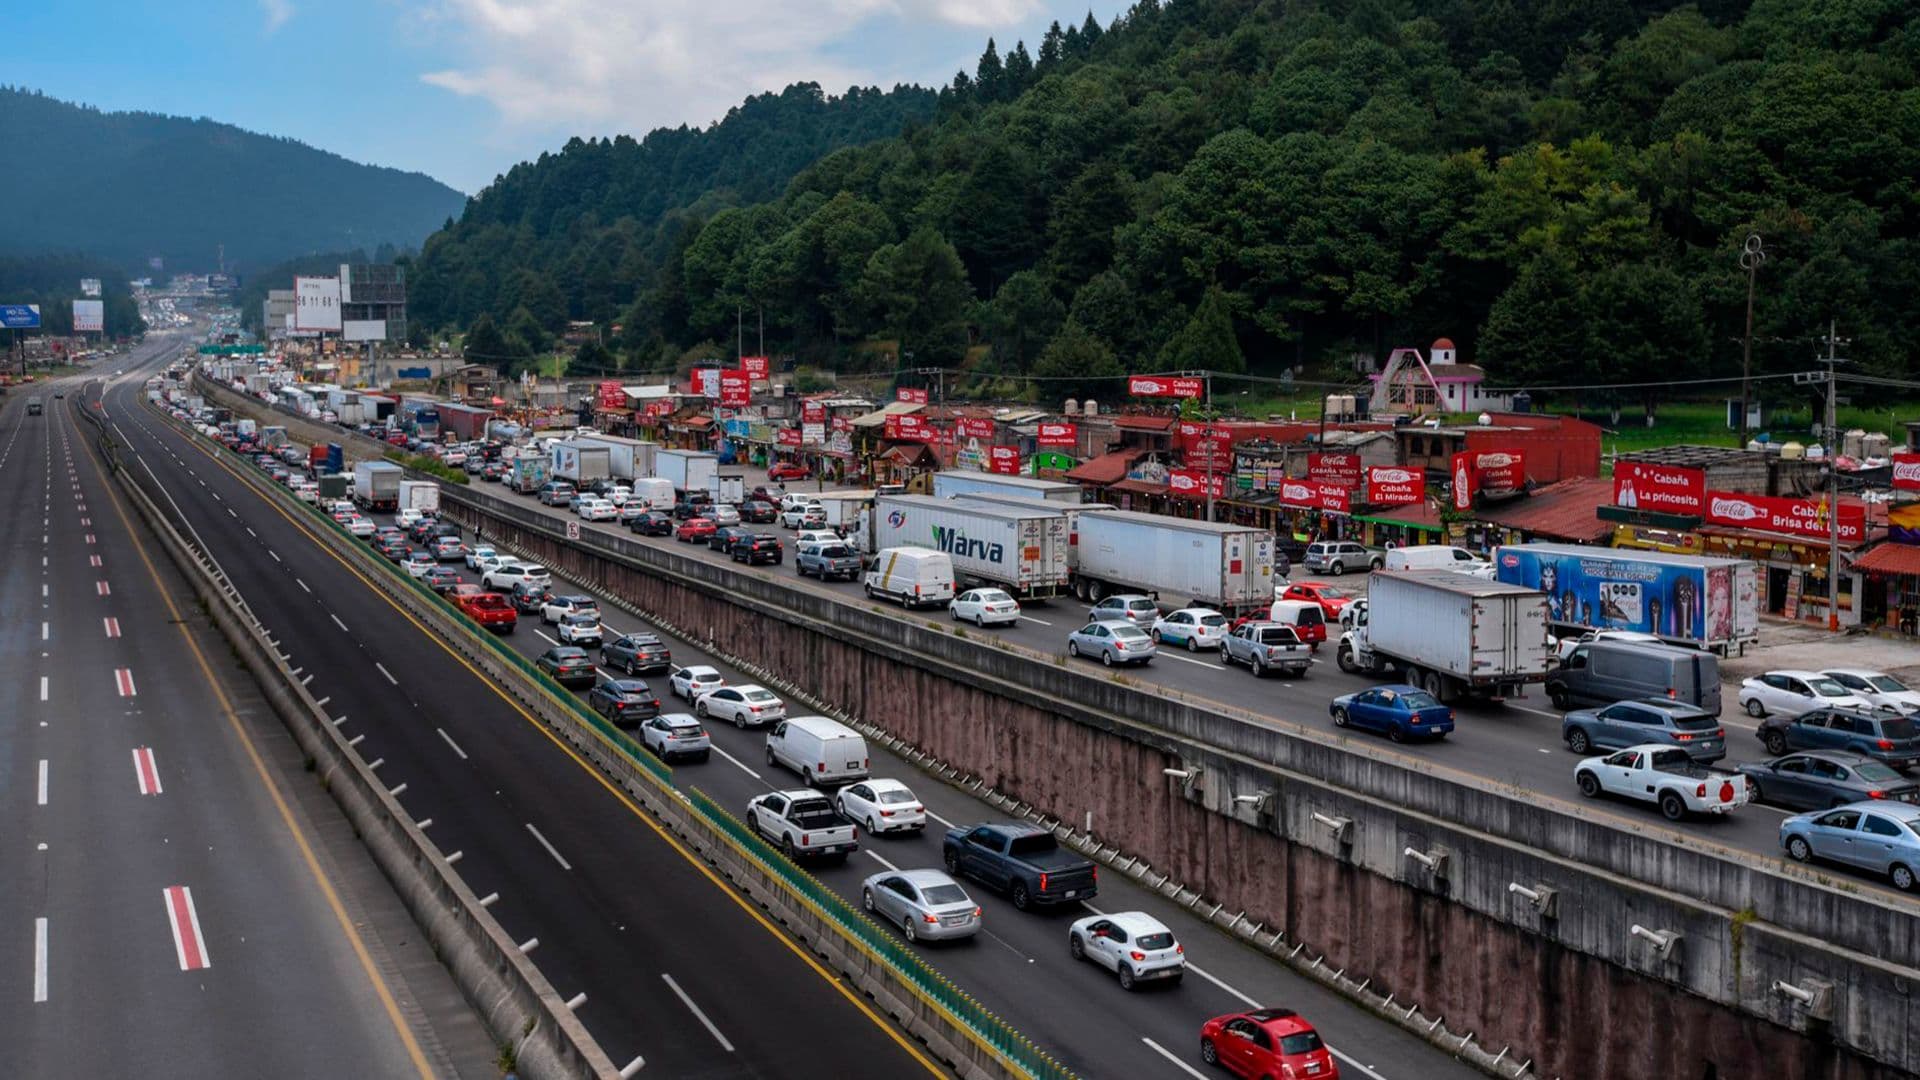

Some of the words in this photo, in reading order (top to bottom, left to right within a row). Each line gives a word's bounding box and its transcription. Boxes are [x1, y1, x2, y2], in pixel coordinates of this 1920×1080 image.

[1173, 380, 1198, 388] Cabaña
[1174, 389, 1197, 398] Nataly
[1311, 466, 1337, 474] CABAÑA
[1486, 469, 1512, 478] Cabaña
[1654, 473, 1689, 486] Cabaña
[1319, 486, 1345, 497] Cabaña
[1380, 484, 1412, 492] Cabaña
[1375, 493, 1383, 501] El
[1385, 493, 1417, 501] Mirador
[1639, 491, 1651, 500] La
[1652, 492, 1699, 507] princesita
[1323, 497, 1342, 509] Vicky
[1713, 501, 1746, 517] Coca-Cola
[1773, 514, 1806, 529] Brisa
[937, 526, 1003, 564] Marva
